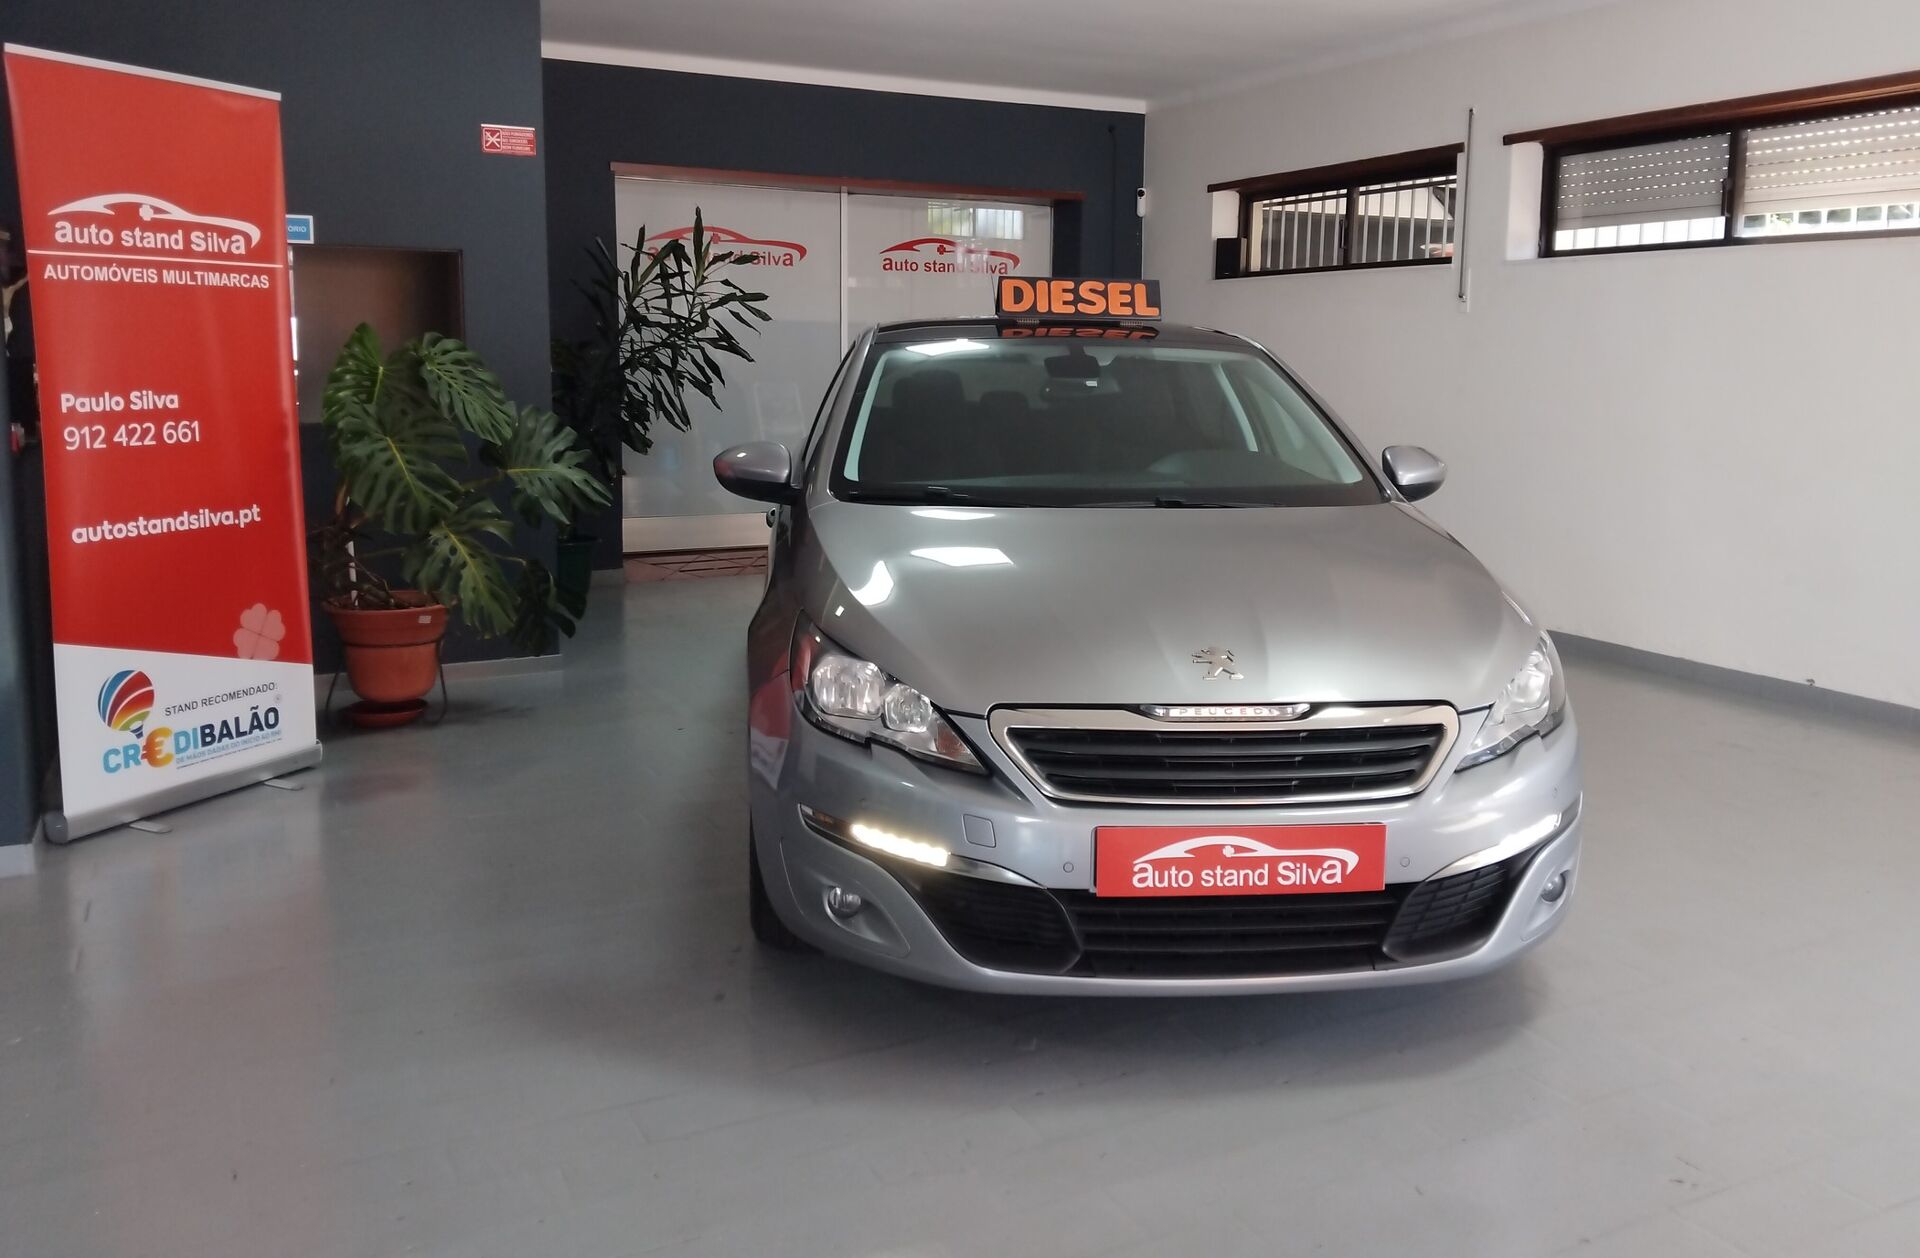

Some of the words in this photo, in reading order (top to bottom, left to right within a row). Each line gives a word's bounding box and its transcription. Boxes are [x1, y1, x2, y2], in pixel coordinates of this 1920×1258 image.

[55, 221, 113, 244] auto
[121, 227, 183, 250] stand
[191, 231, 245, 254] Silva
[44, 263, 157, 283] AUTOMÓVEIS
[163, 270, 269, 288] MULTIMARCAS
[882, 257, 919, 271] auto
[1001, 279, 1160, 317] DIESEL
[61, 392, 125, 413] Paulo
[130, 390, 179, 410] Silva
[63, 425, 107, 450] 912
[113, 423, 156, 446] 422
[163, 420, 200, 444] 661
[71, 504, 261, 544] autostandsilva.pt
[165, 701, 199, 717] STAND
[201, 682, 278, 708] RECOMENDADO:
[1132, 863, 1194, 888] auto
[1201, 863, 1268, 887] stand
[1277, 859, 1342, 885] Silva
